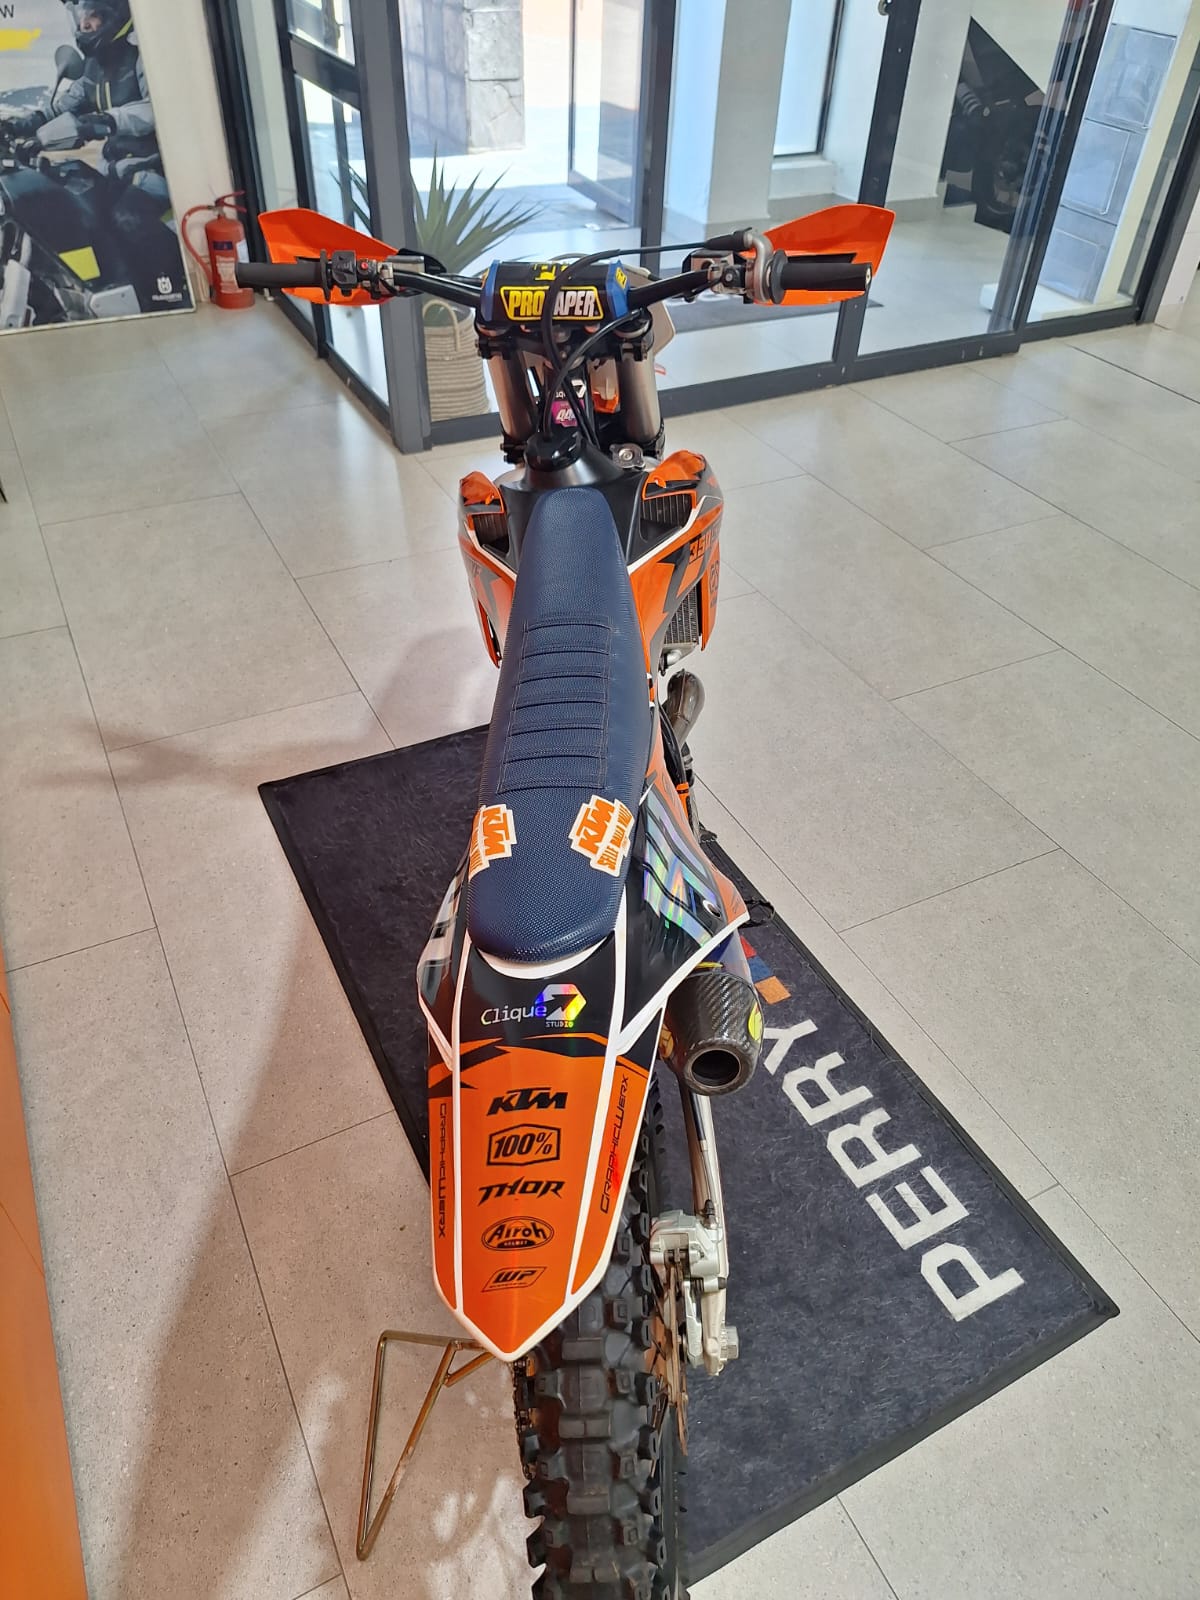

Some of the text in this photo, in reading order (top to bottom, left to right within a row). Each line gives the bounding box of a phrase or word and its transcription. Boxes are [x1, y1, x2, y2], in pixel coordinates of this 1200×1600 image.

[482, 806, 511, 857] KTM
[576, 798, 615, 855] KTM
[481, 1005, 547, 1026] Clique
[486, 1087, 568, 1116] KTM
[493, 1131, 553, 1159] 100%
[762, 1018, 1025, 1322] PERRY
[477, 1176, 565, 1206] THOR
[493, 1270, 537, 1284] WP
